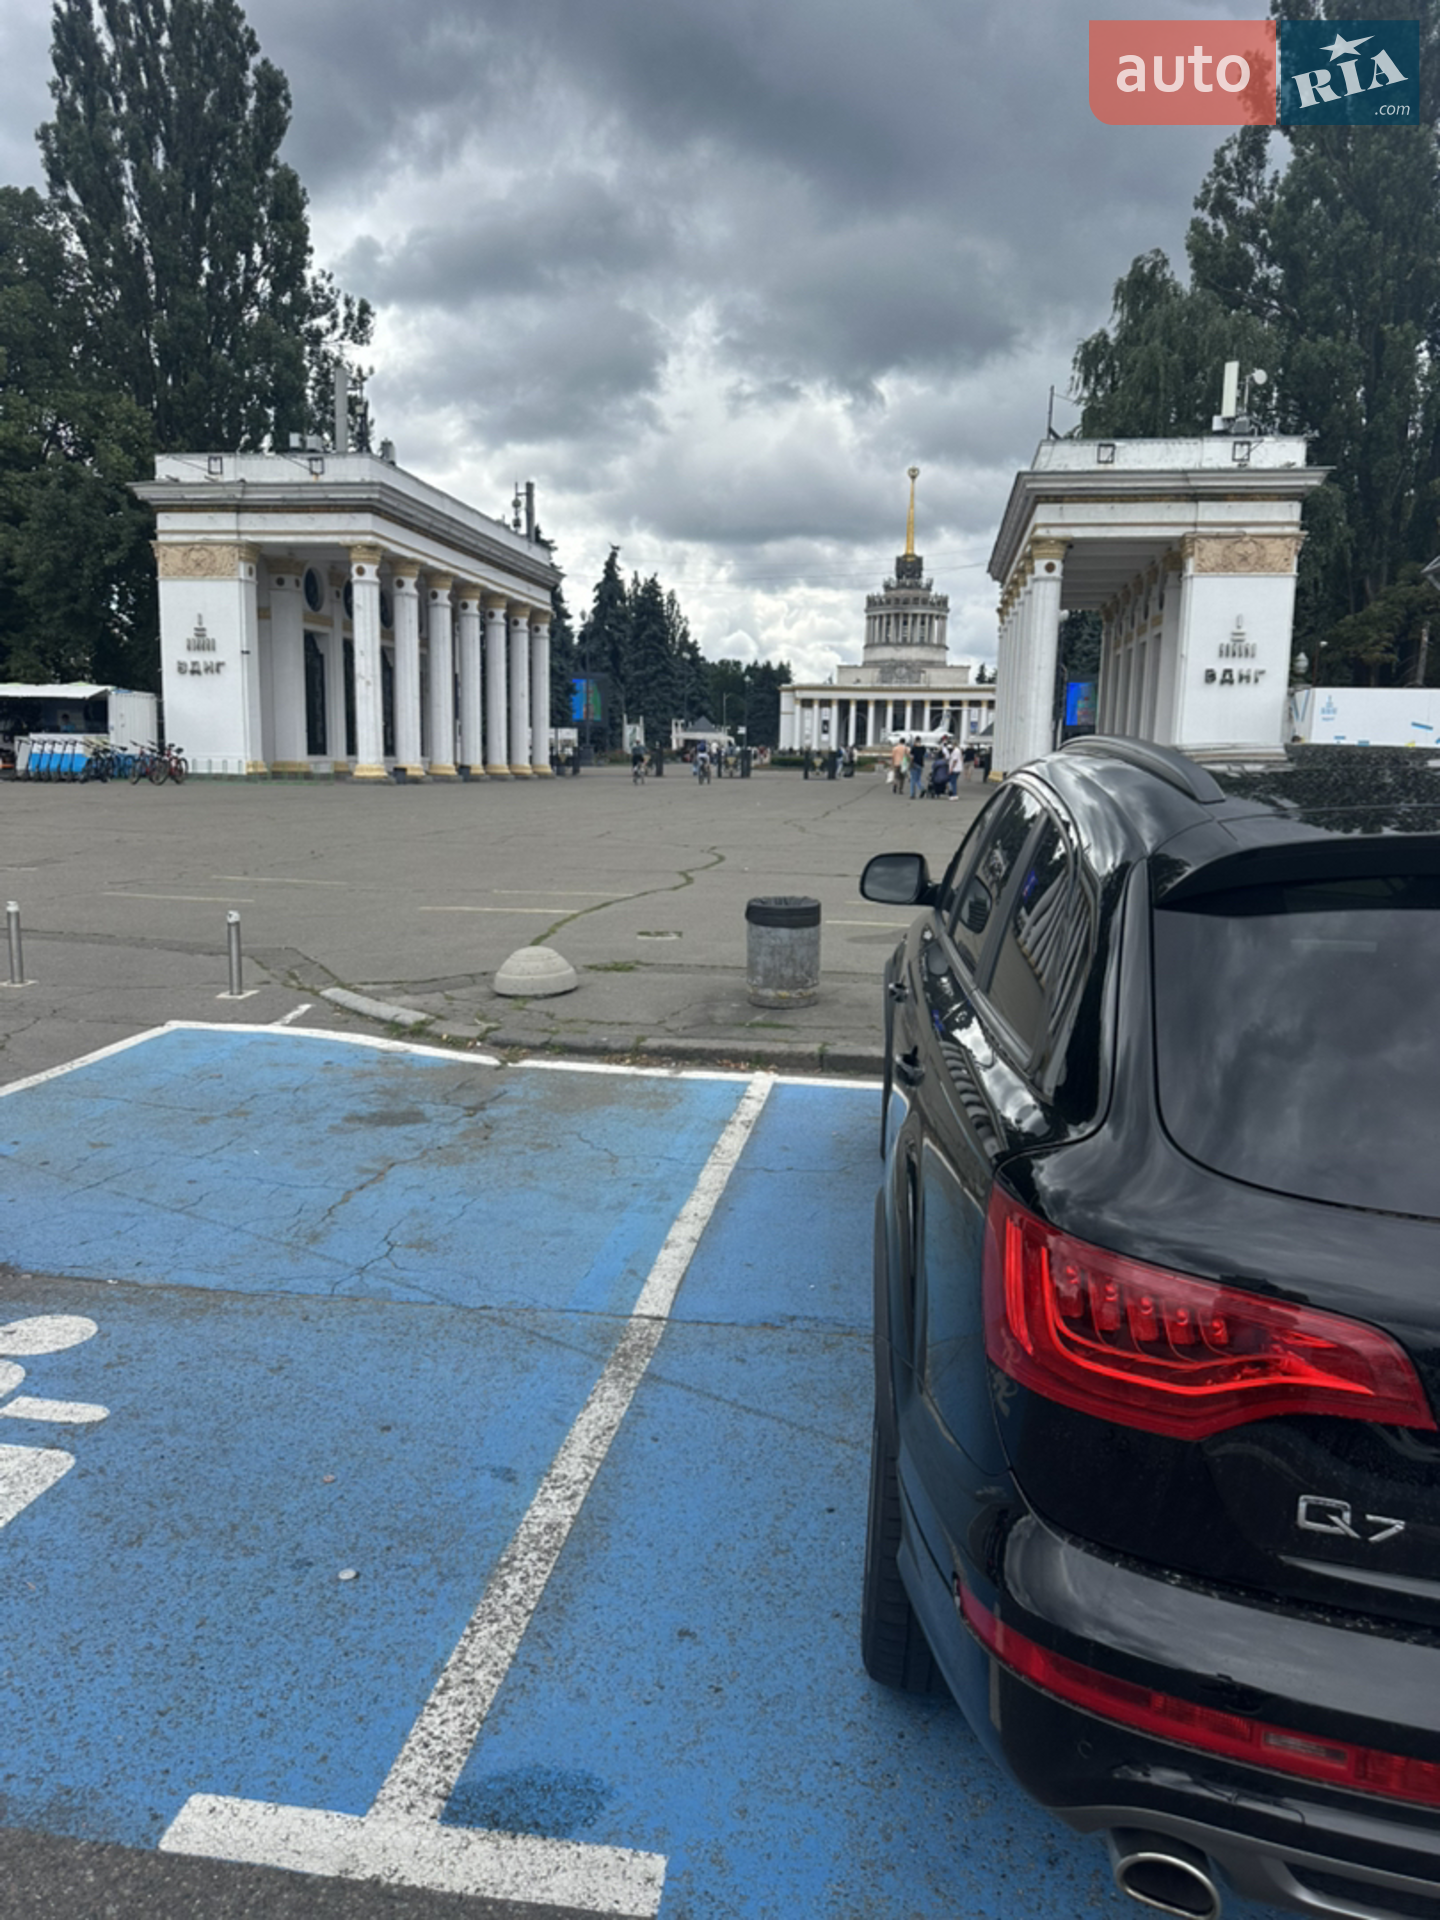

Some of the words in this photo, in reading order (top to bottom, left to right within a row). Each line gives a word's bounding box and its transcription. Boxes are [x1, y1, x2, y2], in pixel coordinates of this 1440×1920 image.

[177, 660, 226, 676] ВДНГ
[1204, 668, 1266, 686] ВДНГ
[1297, 1495, 1406, 1543] Q7
